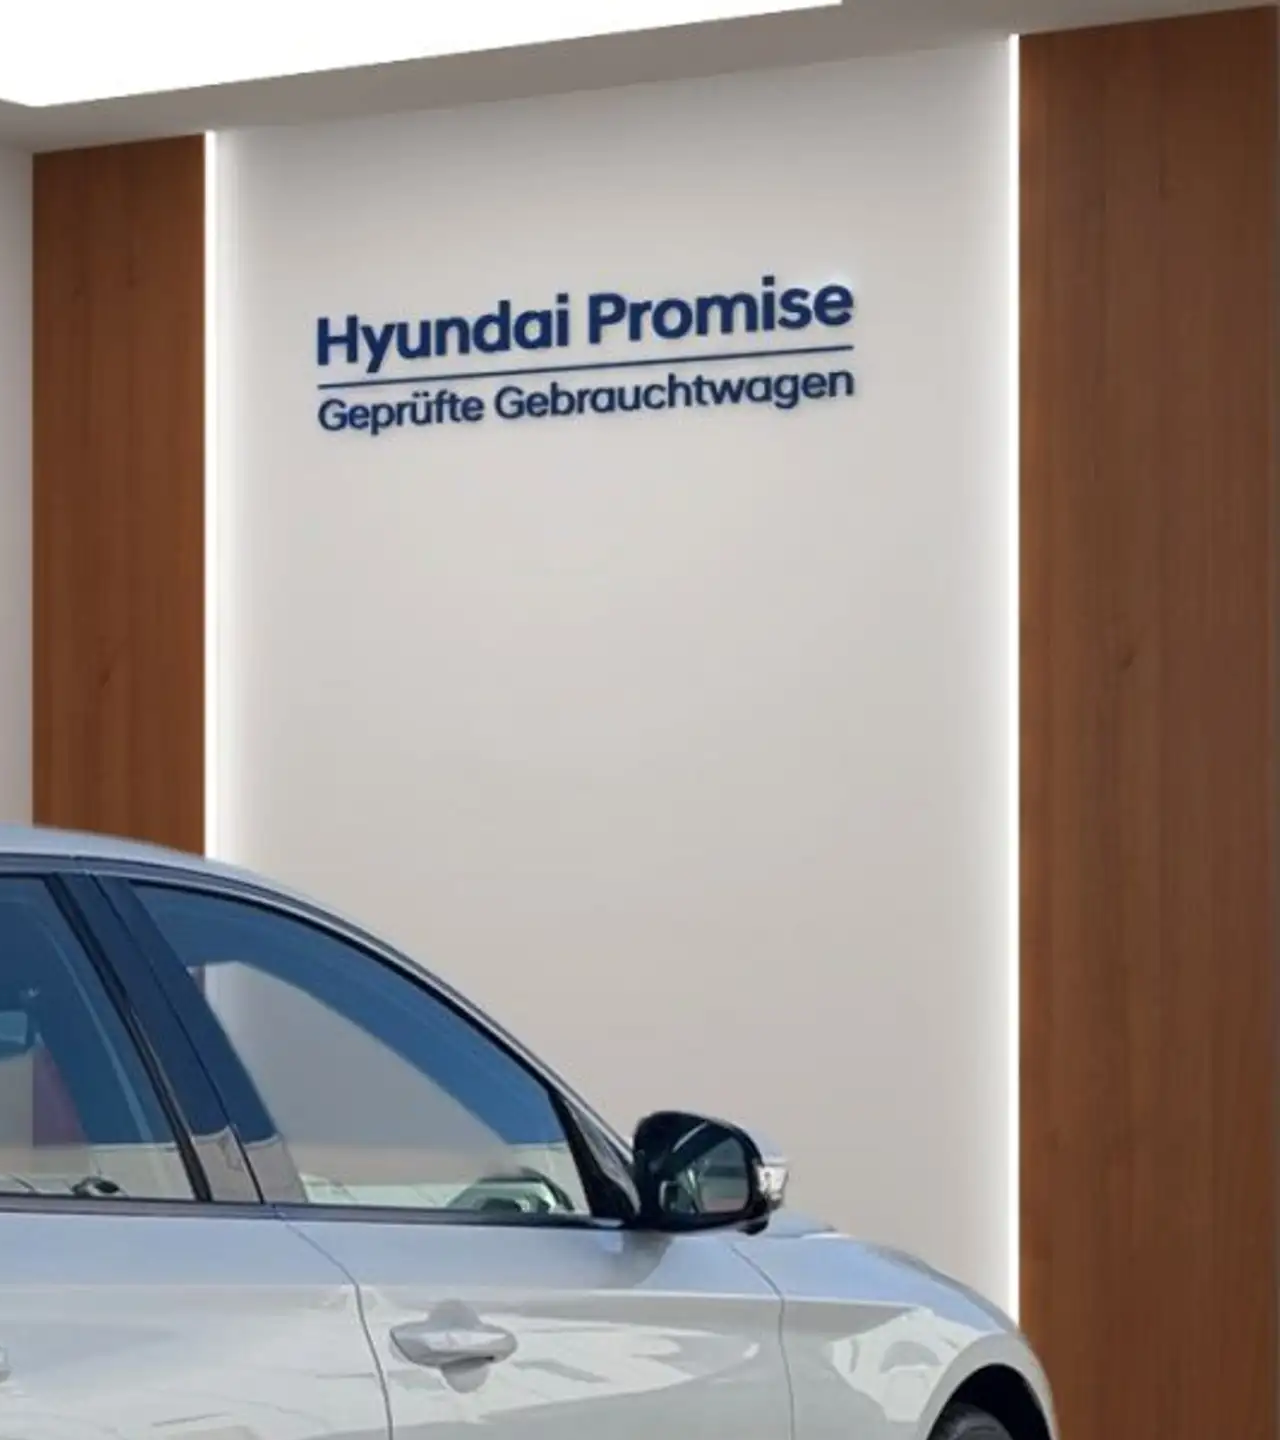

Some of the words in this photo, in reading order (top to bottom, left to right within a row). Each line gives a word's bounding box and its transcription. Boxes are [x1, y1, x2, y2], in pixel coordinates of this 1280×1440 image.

[316, 292, 571, 375] Hyundai
[587, 275, 855, 345] Promise
[317, 389, 486, 436] Geprüfte
[493, 369, 855, 420] Gebrauchtwagen
